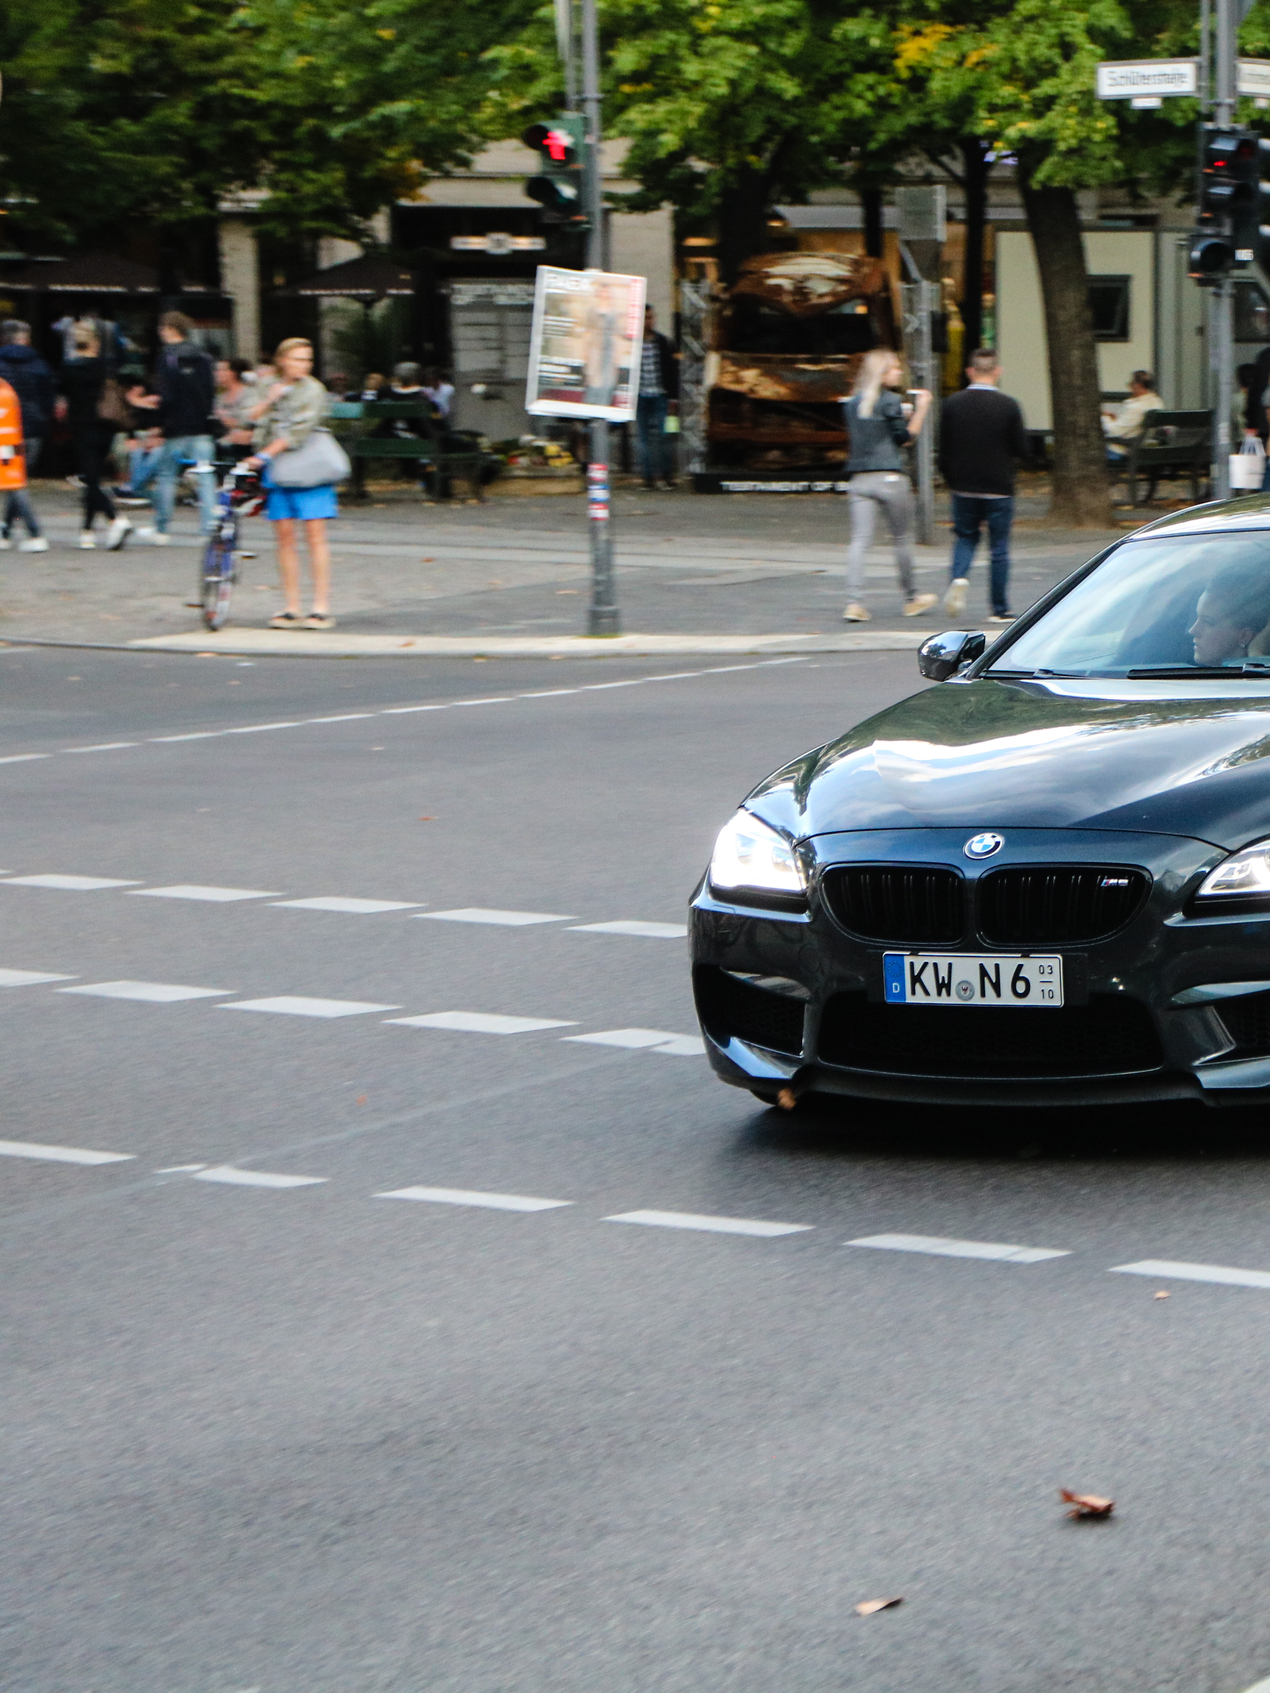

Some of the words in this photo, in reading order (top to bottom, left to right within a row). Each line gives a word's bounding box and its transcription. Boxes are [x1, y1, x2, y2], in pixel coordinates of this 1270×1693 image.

[1038, 964, 1054, 975] 03
[909, 961, 953, 997] KW
[892, 982, 900, 993] D
[1041, 988, 1054, 999] 10
